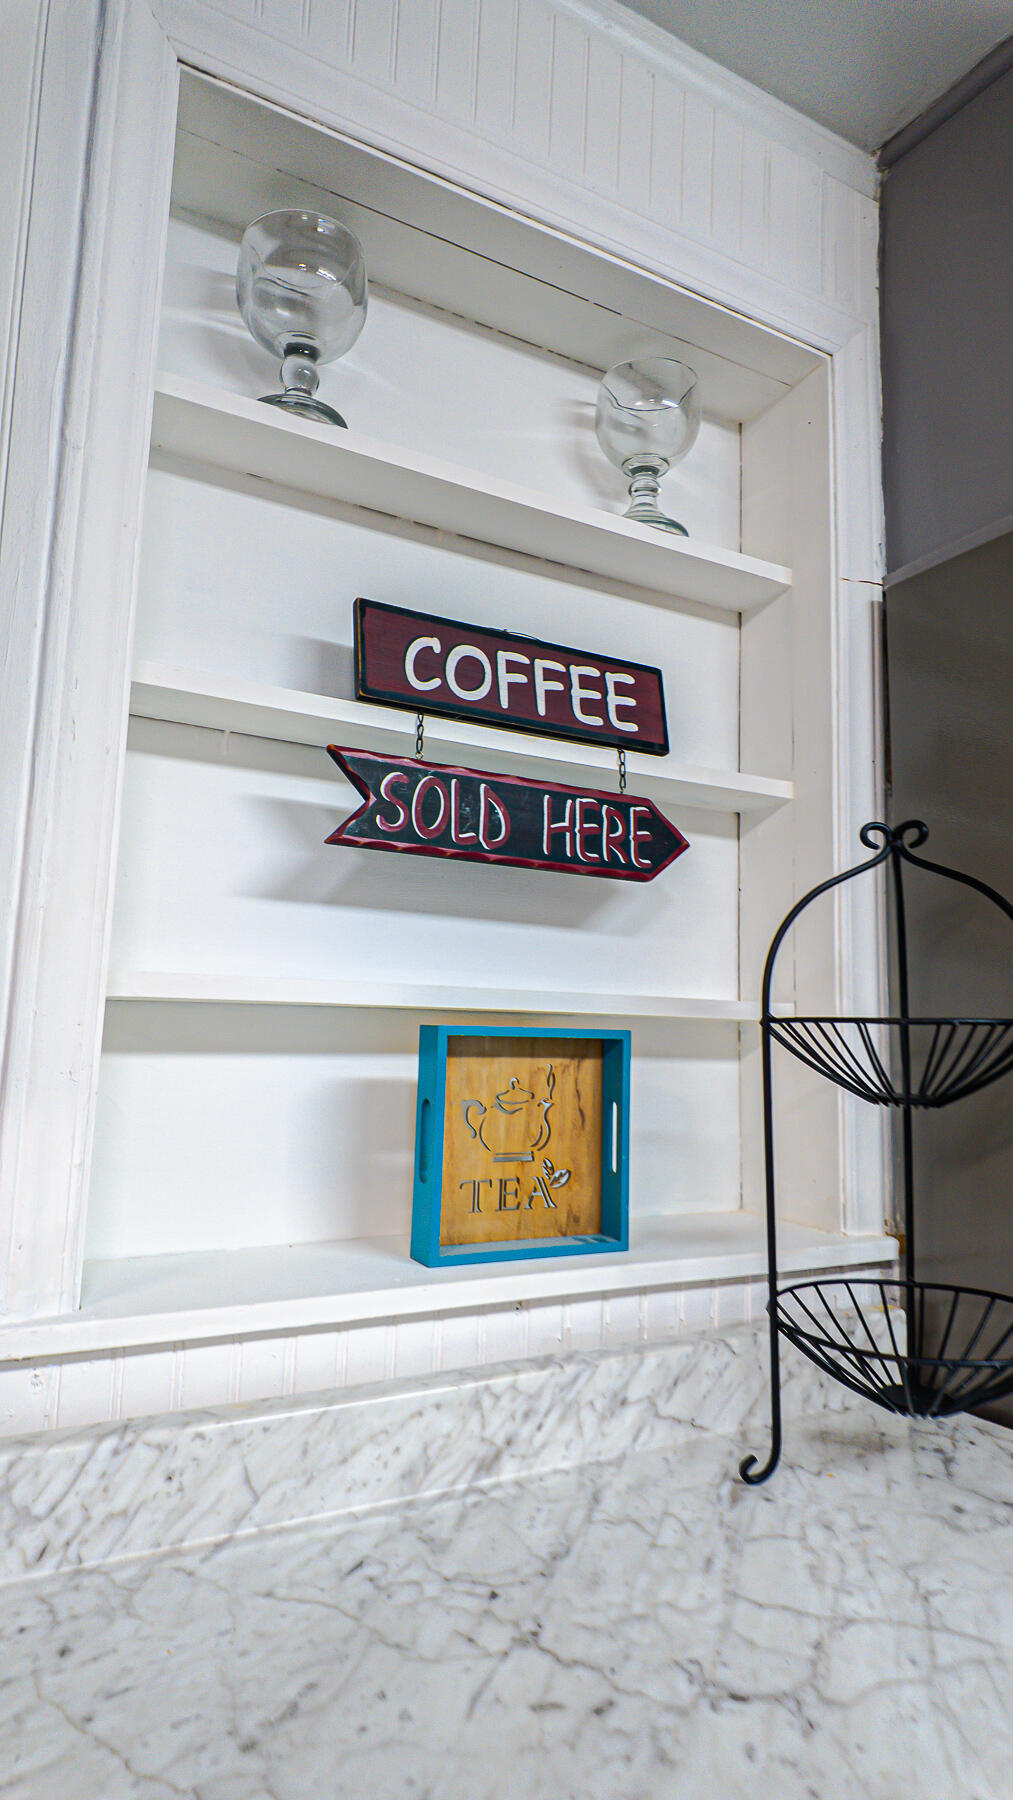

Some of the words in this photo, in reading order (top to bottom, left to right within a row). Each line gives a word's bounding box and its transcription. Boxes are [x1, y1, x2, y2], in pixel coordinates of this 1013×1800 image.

[404, 636, 639, 733] COFFEE
[375, 771, 511, 850] SOLD
[542, 794, 653, 868] HERE
[459, 1176, 558, 1214] TEA
